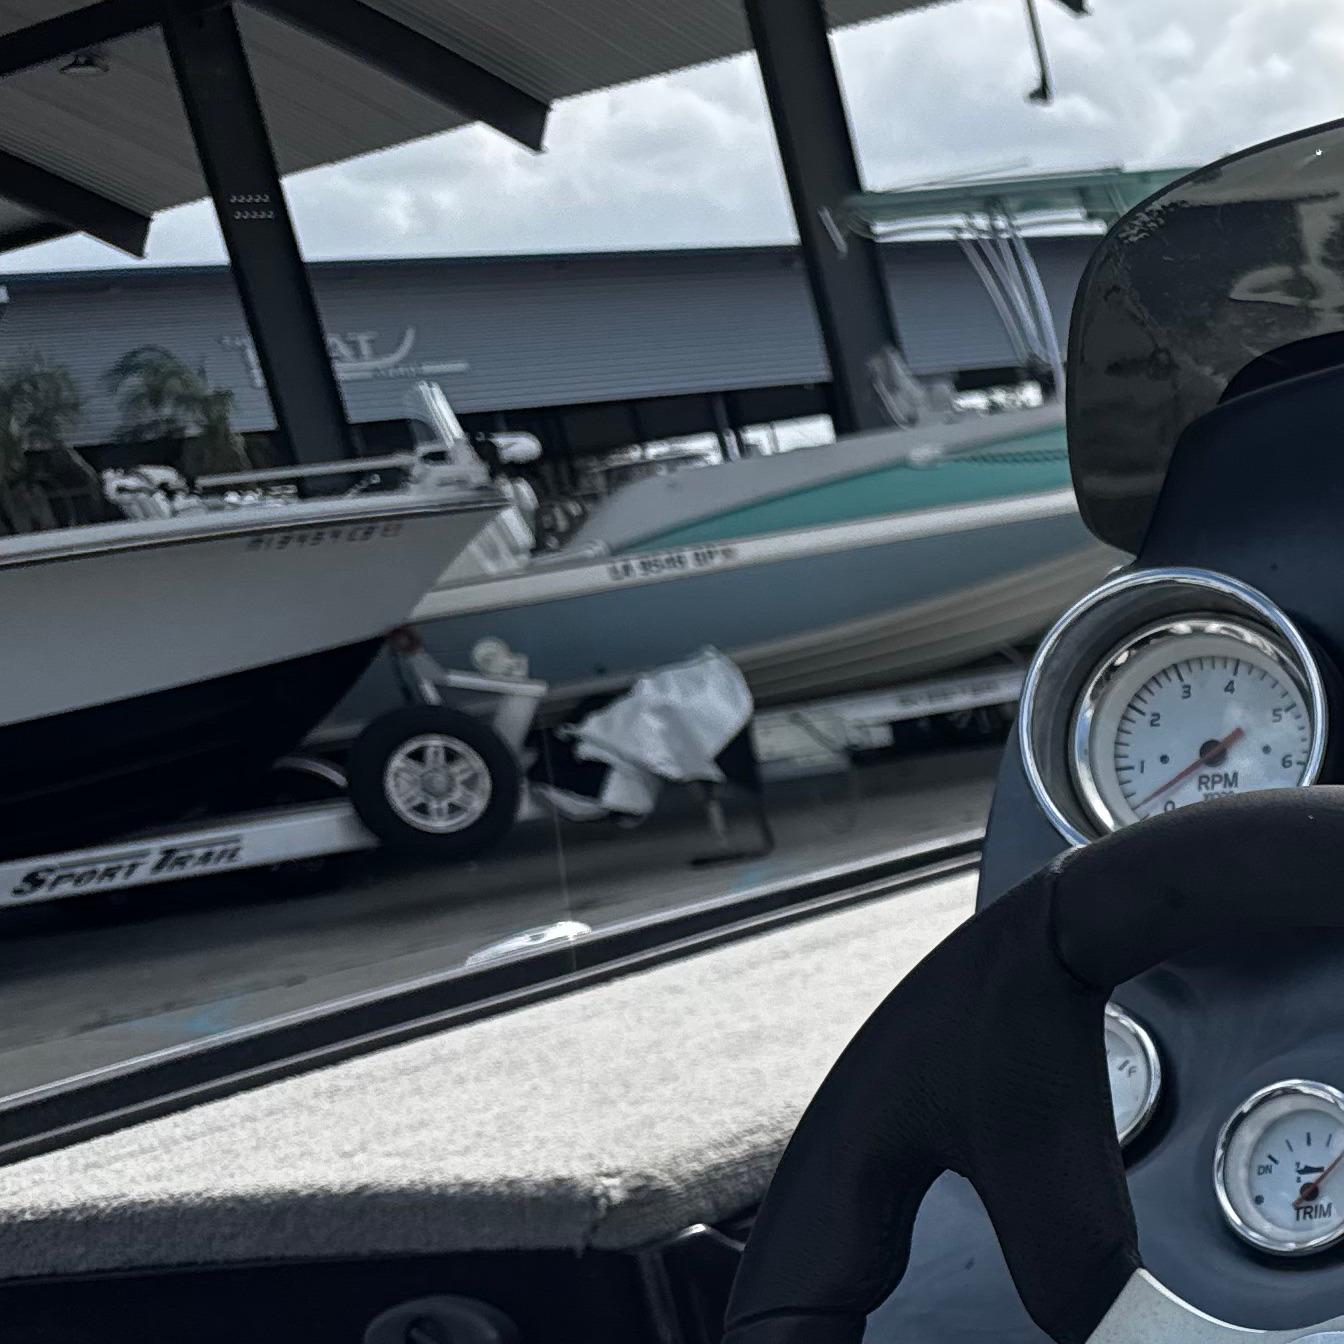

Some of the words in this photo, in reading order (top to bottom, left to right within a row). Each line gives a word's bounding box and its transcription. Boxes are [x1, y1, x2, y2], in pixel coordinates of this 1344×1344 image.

[1182, 684, 1192, 699] 3
[1224, 680, 1235, 694] 4
[1150, 713, 1161, 727] 2
[1272, 708, 1283, 723] 5
[1281, 754, 1293, 769] 6
[1198, 771, 1239, 792] RPM
[1128, 1066, 1137, 1077] F
[1257, 1165, 1273, 1176] DN
[1295, 1203, 1332, 1221] TRIM
